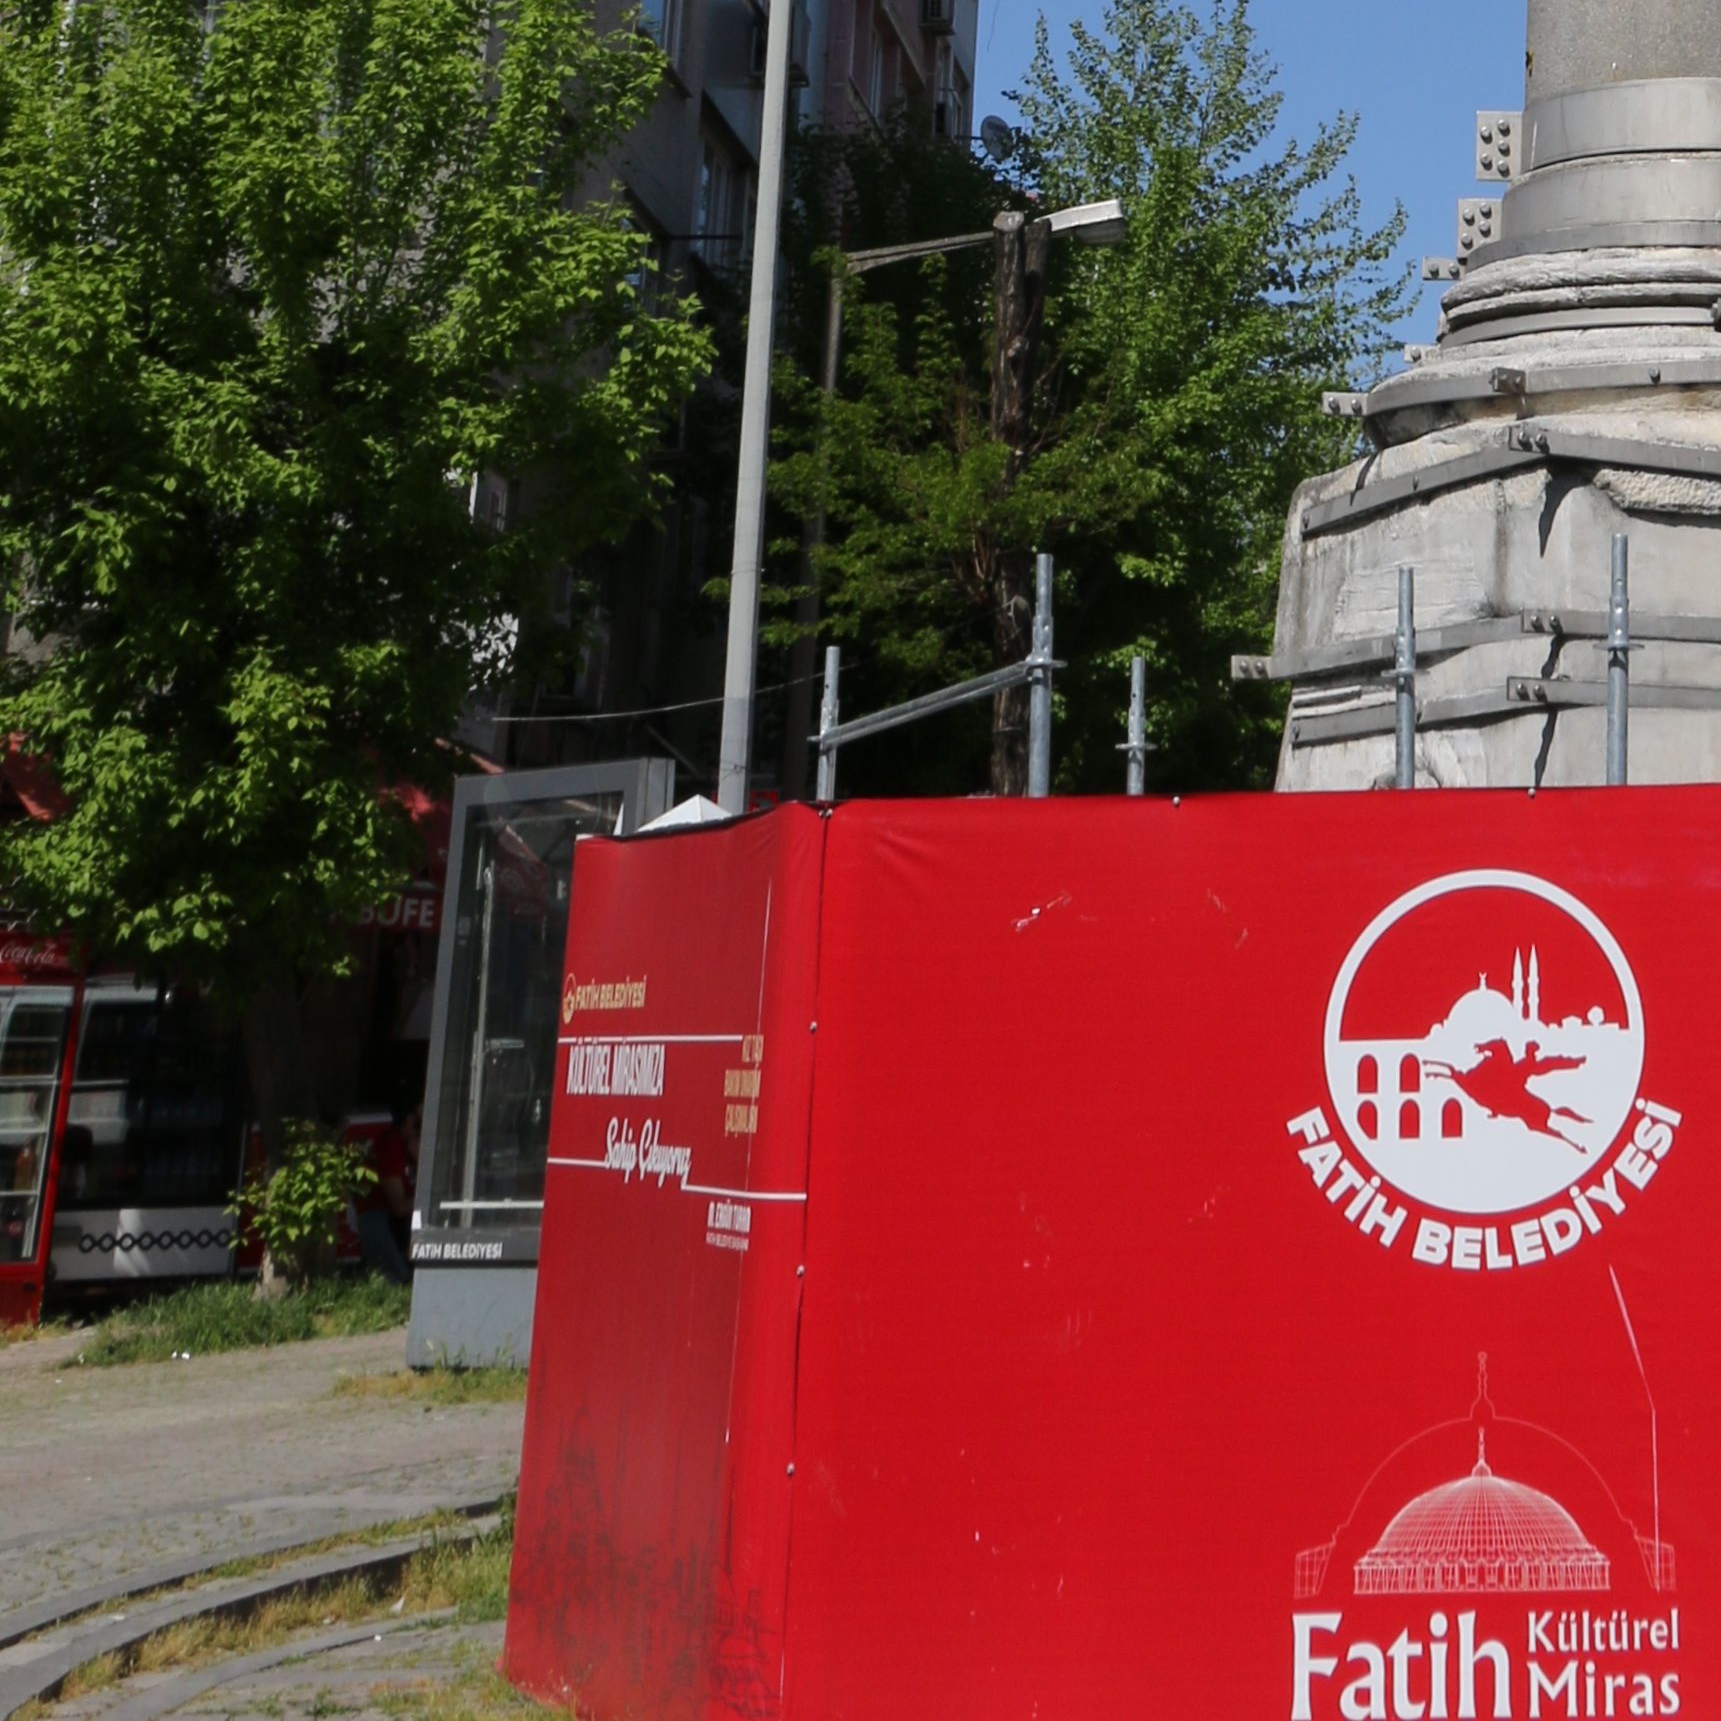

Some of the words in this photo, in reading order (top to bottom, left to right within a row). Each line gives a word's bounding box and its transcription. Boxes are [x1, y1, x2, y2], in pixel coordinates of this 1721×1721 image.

[1285, 1105, 1409, 1248] FATİH
[1411, 1097, 1683, 1271] BELEDİYESİ
[1289, 1609, 1513, 1721] Fatih
[1526, 1607, 1680, 1653] Kültürel
[1526, 1659, 1681, 1718] Miras
